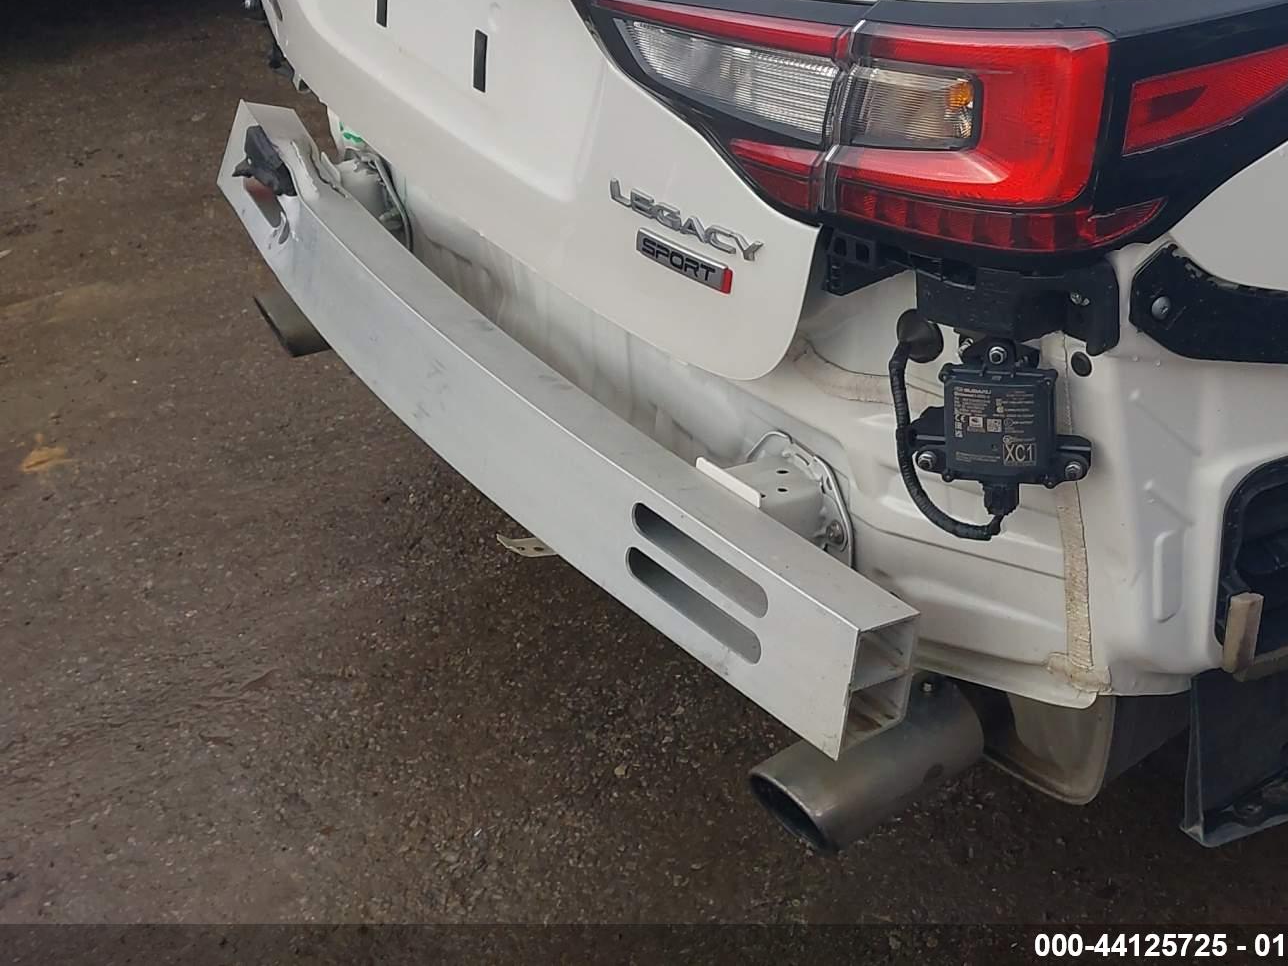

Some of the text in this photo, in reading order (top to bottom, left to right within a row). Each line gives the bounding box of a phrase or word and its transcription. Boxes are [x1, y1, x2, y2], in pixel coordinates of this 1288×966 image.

[609, 177, 765, 262] LEGACY
[640, 237, 717, 282] SPORT
[1005, 443, 1033, 462] XC1
